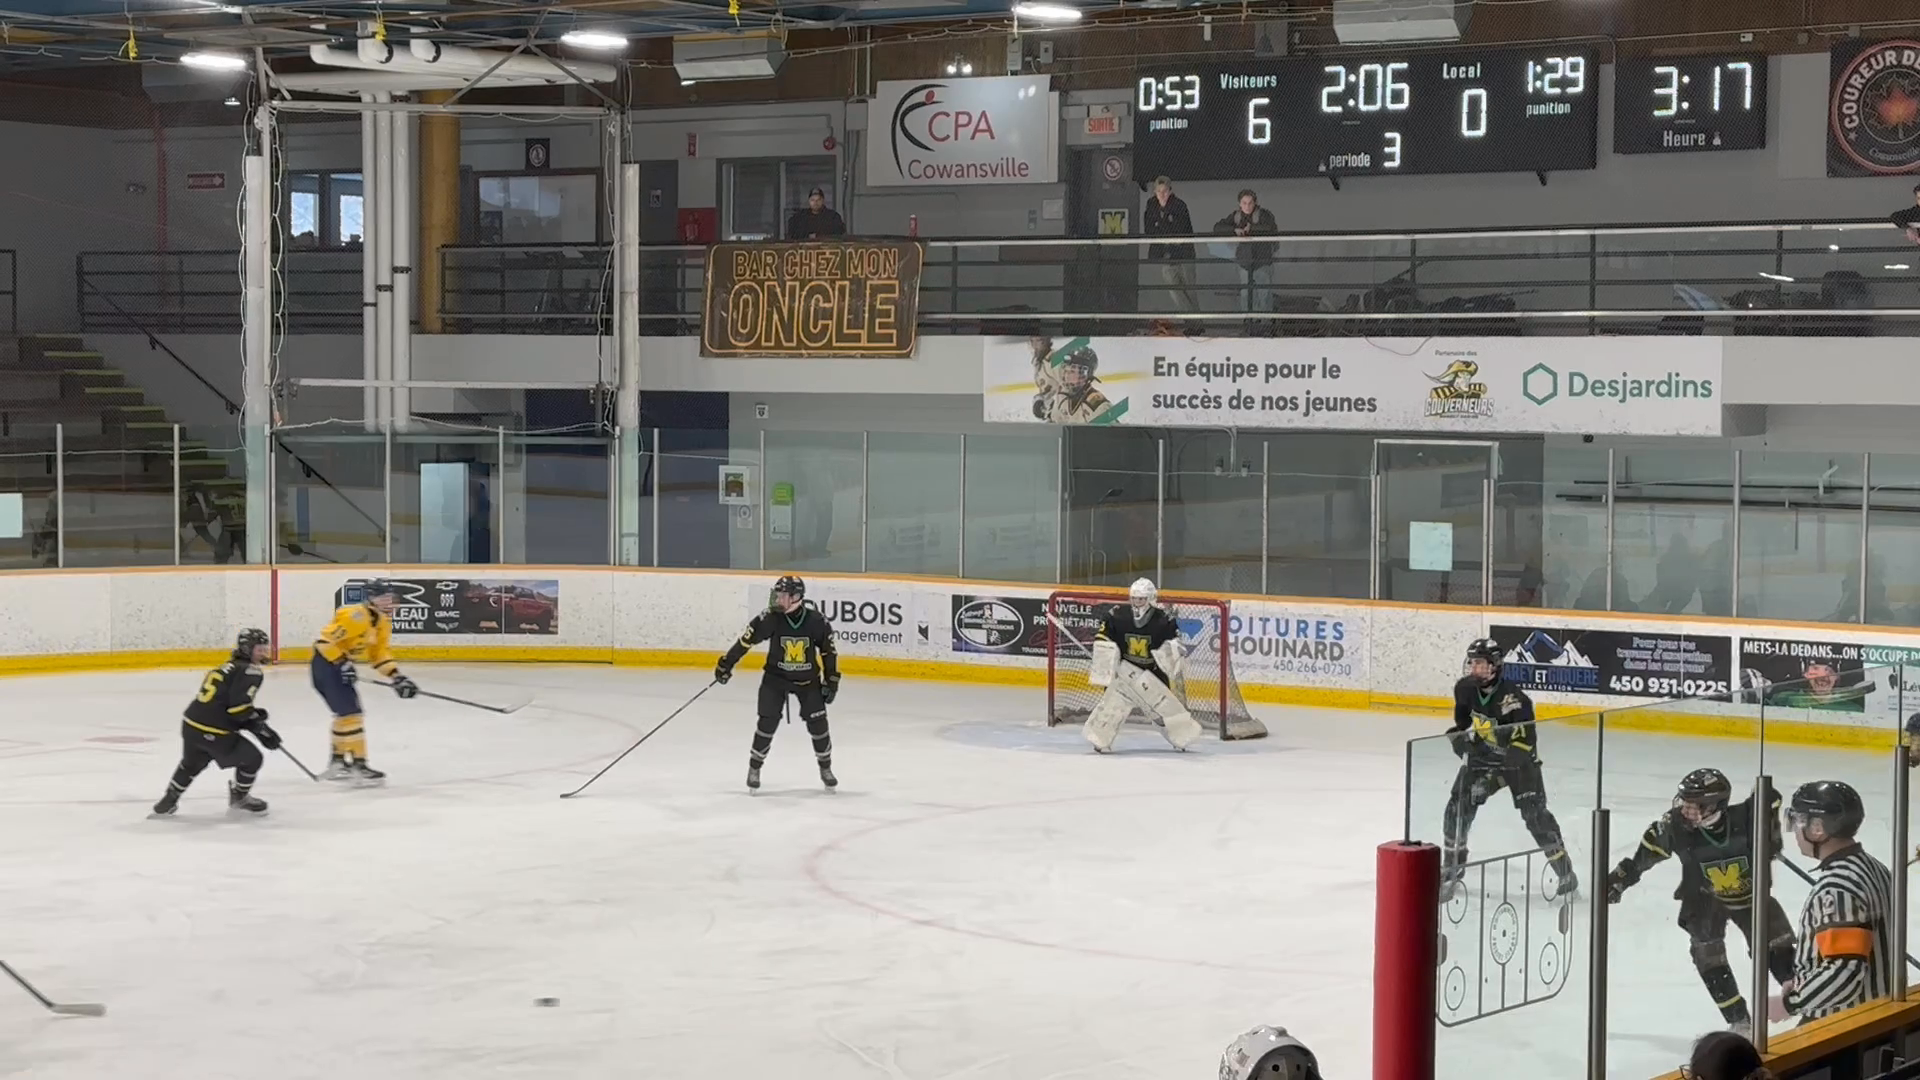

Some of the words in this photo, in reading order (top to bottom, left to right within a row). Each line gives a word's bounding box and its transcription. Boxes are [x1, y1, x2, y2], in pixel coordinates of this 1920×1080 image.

[1220, 73, 1277, 90] Visiteurs
[1442, 62, 1481, 79] Local
[1528, 56, 1585, 94] 1:29
[1139, 75, 1199, 111] 0:53
[1321, 62, 1410, 113] 2:06
[1653, 62, 1752, 116] 3:17
[1842, 50, 1898, 129] COUREUR
[1249, 98, 1271, 144] 6
[1462, 88, 1487, 136] 0
[1526, 102, 1571, 118] punition
[928, 110, 996, 142] CPA
[1150, 117, 1188, 132] punition
[1383, 132, 1400, 167] 3
[1663, 130, 1706, 147] Heure
[908, 158, 1029, 180] Cowansville
[733, 250, 778, 280] BAR
[784, 249, 841, 279] CHEZ
[846, 248, 899, 278] MON
[728, 280, 900, 347] ONCLE
[1153, 356, 1179, 377] En
[1185, 357, 1259, 383] équipe
[1264, 361, 1316, 383] pour
[1321, 357, 1341, 379] le
[1568, 371, 1713, 403] Desjardins
[1152, 389, 1222, 410] succès
[1228, 389, 1255, 410] de
[1261, 394, 1299, 412] nos
[1303, 390, 1377, 417] jeunes
[1424, 398, 1495, 417] GOUVERNEURS
[392, 608, 428, 621] LEAU
[1041, 603, 1092, 615] NUVELLE
[391, 621, 424, 630] VILLE
[1033, 615, 1100, 629] PRRIÉTAIRE
[1210, 614, 1344, 641] TOITURES
[831, 630, 903, 646] nagement
[1127, 635, 1150, 657] M
[1208, 634, 1344, 662] CHOUINARD
[1632, 636, 1656, 648] Pour
[1657, 638, 1678, 650] tous
[1743, 641, 1789, 655] METS-LA
[783, 638, 807, 663] M
[1273, 660, 1294, 673] 450
[1297, 661, 1352, 677] 266-0730
[1503, 664, 1534, 681] AREY
[1535, 670, 1548, 684] ET
[1521, 683, 1573, 692] EXCAVATION
[1609, 674, 1643, 692] 450
[1648, 676, 1728, 698] 931-0225
[1704, 859, 1746, 892] M
